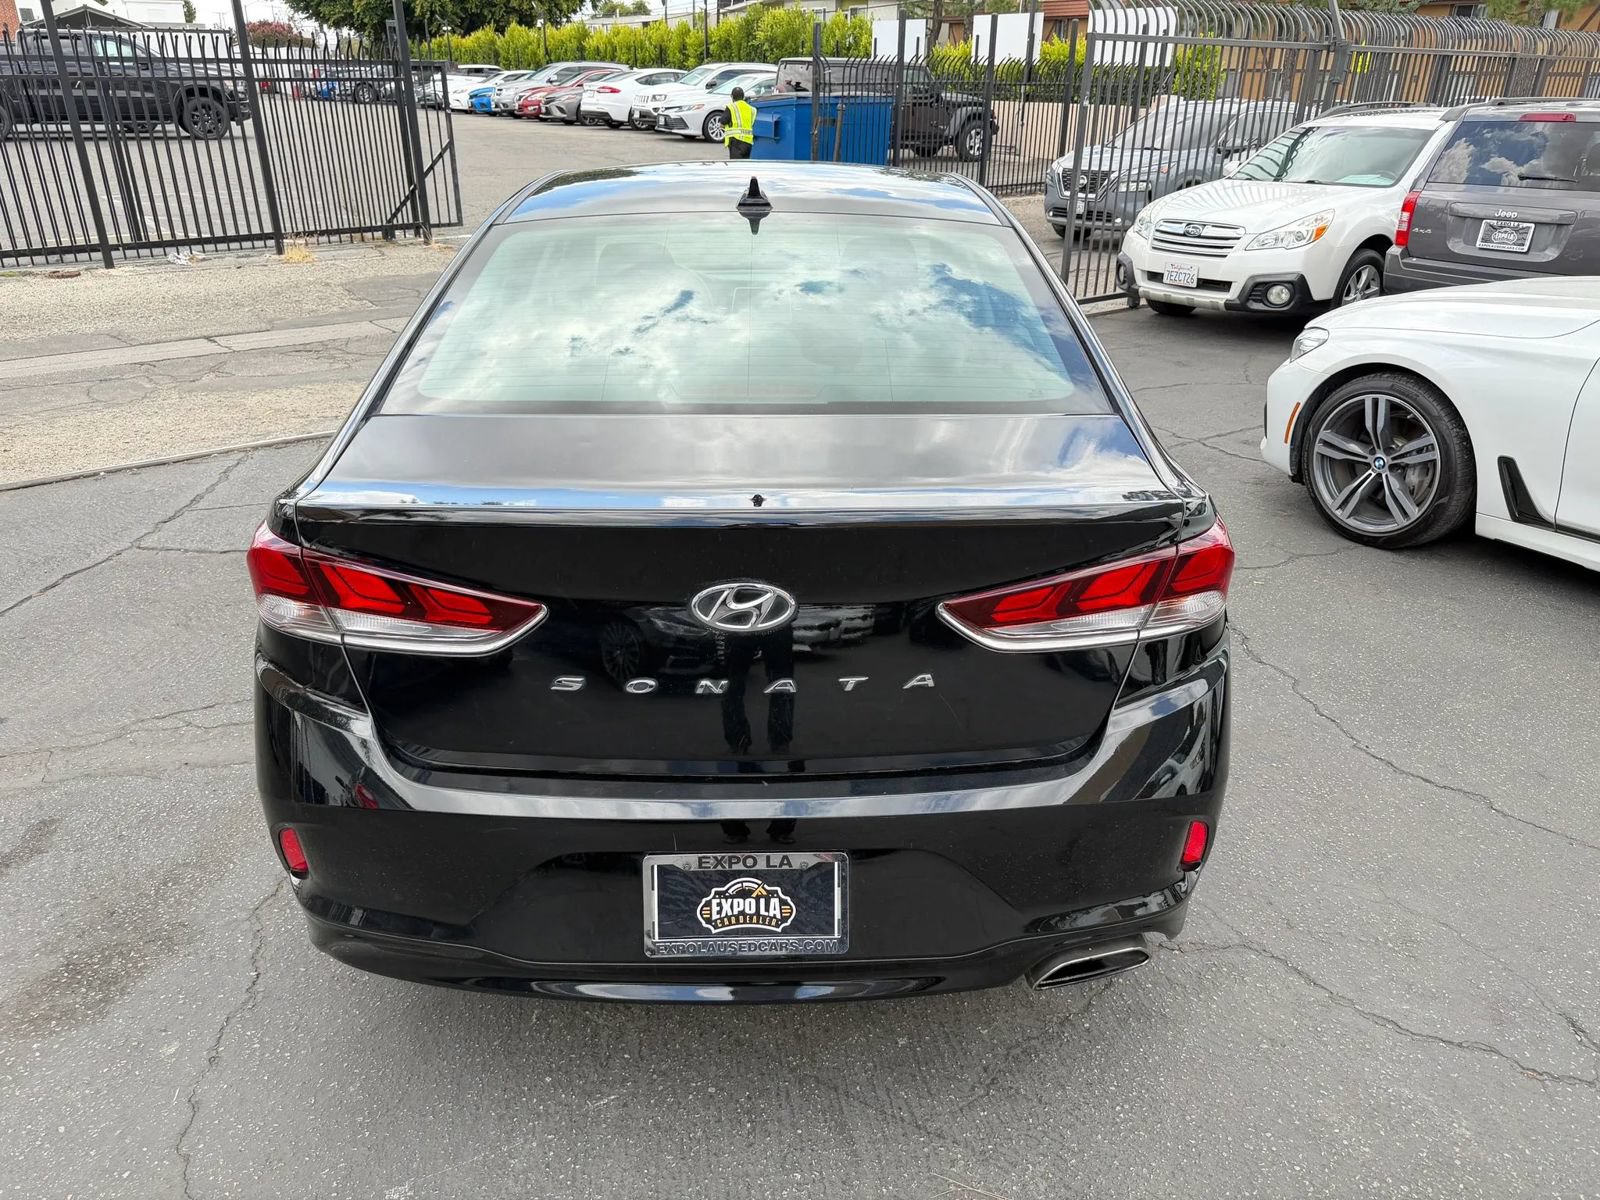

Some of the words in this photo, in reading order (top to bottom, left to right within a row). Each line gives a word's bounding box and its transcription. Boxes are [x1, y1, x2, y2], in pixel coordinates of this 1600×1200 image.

[1494, 209, 1518, 218] Jeep
[550, 673, 935, 694] SONATA
[698, 855, 758, 869] EXPO
[765, 855, 793, 868] LA
[712, 898, 756, 920] EXPO
[760, 898, 781, 919] LA
[656, 940, 838, 955] EXPOLAUSEDCARS.COM
